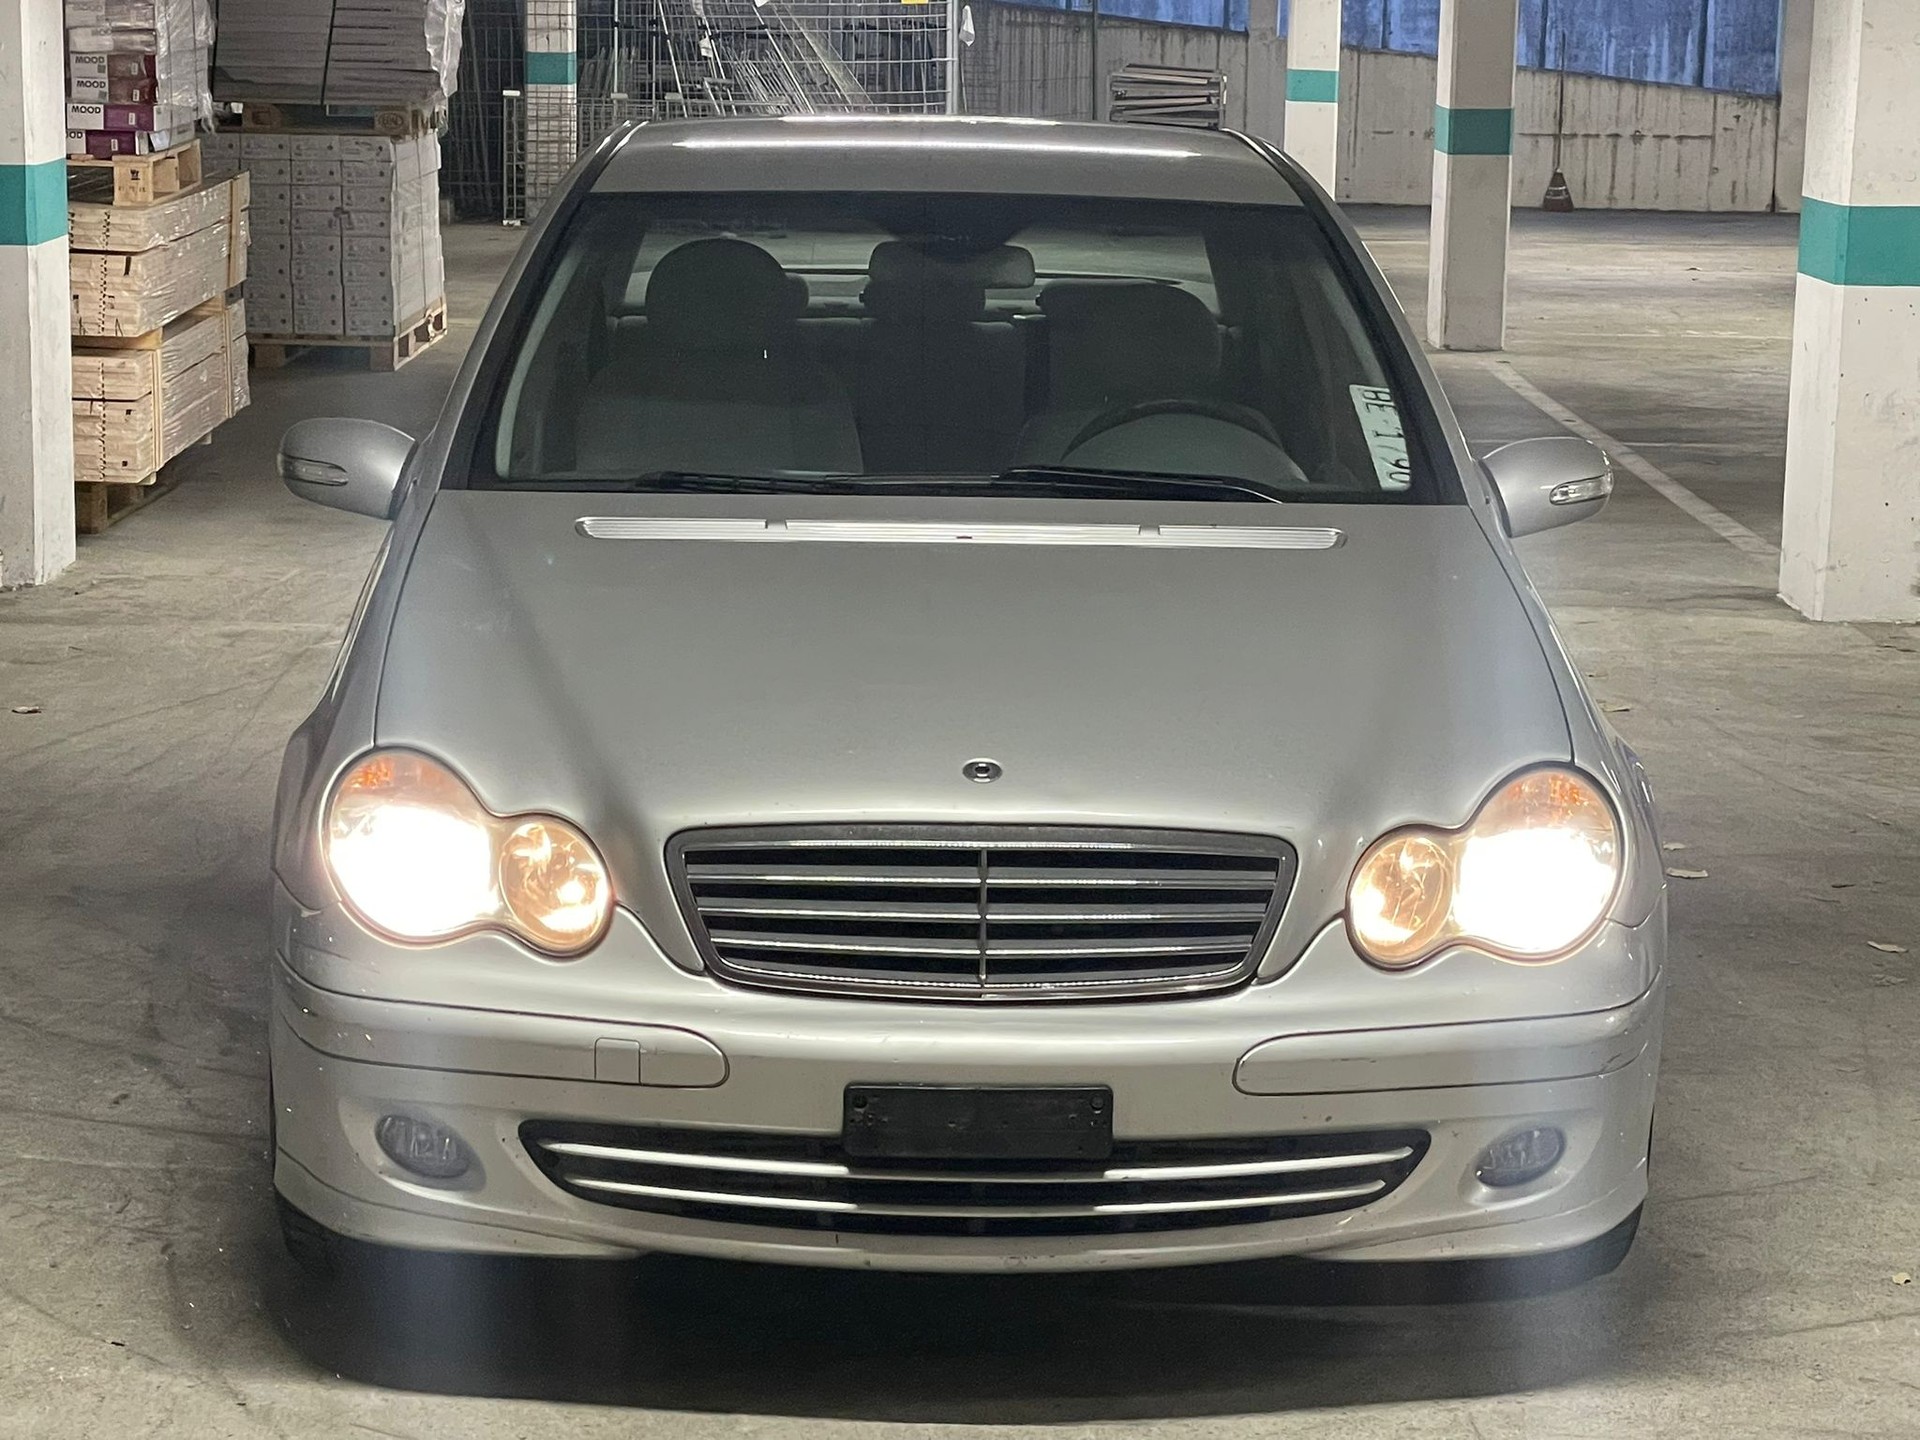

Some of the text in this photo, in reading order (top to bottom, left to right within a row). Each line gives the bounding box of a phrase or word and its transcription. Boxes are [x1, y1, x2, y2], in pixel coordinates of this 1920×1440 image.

[75, 56, 105, 64] MOOD
[76, 80, 106, 88] MOOD
[71, 105, 101, 114] MOOD
